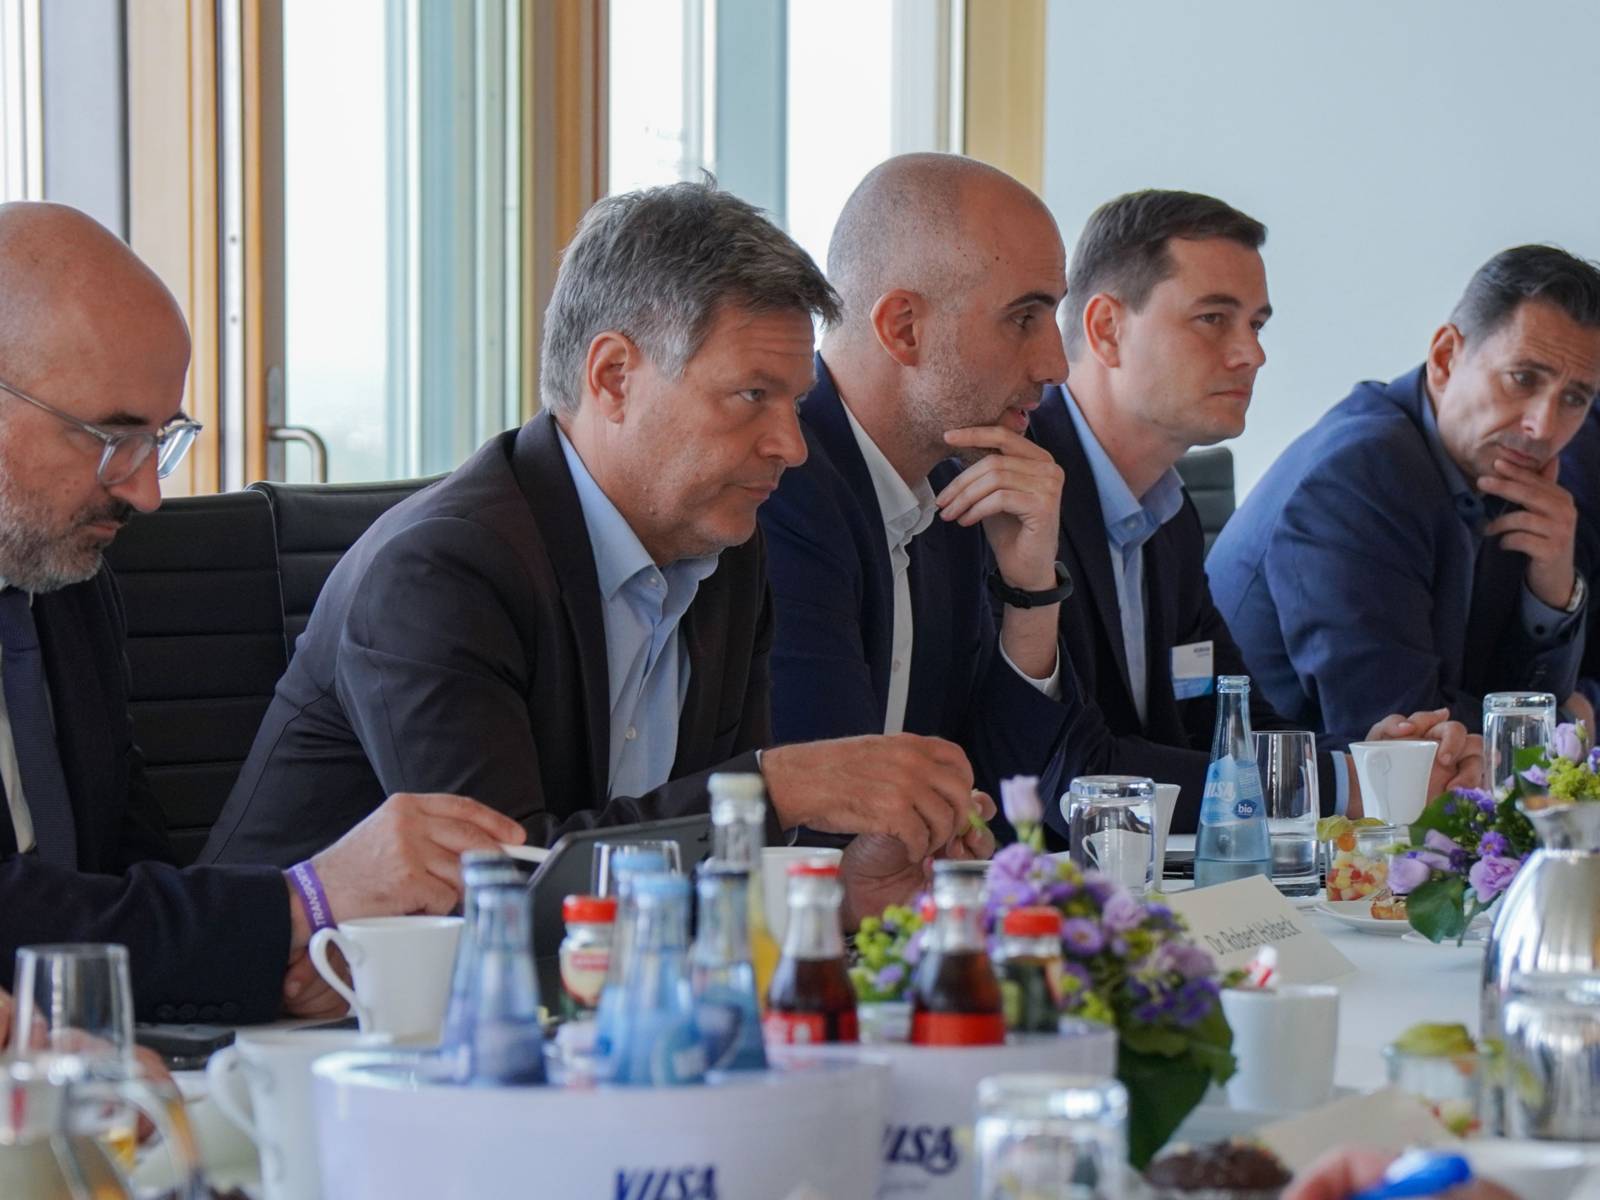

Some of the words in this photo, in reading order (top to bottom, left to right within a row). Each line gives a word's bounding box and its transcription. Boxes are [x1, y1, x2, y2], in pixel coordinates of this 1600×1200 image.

[1203, 781, 1236, 801] ILSA
[1237, 803, 1254, 814] bio
[1218, 921, 1259, 951] Robert
[880, 1122, 960, 1176] ILSA
